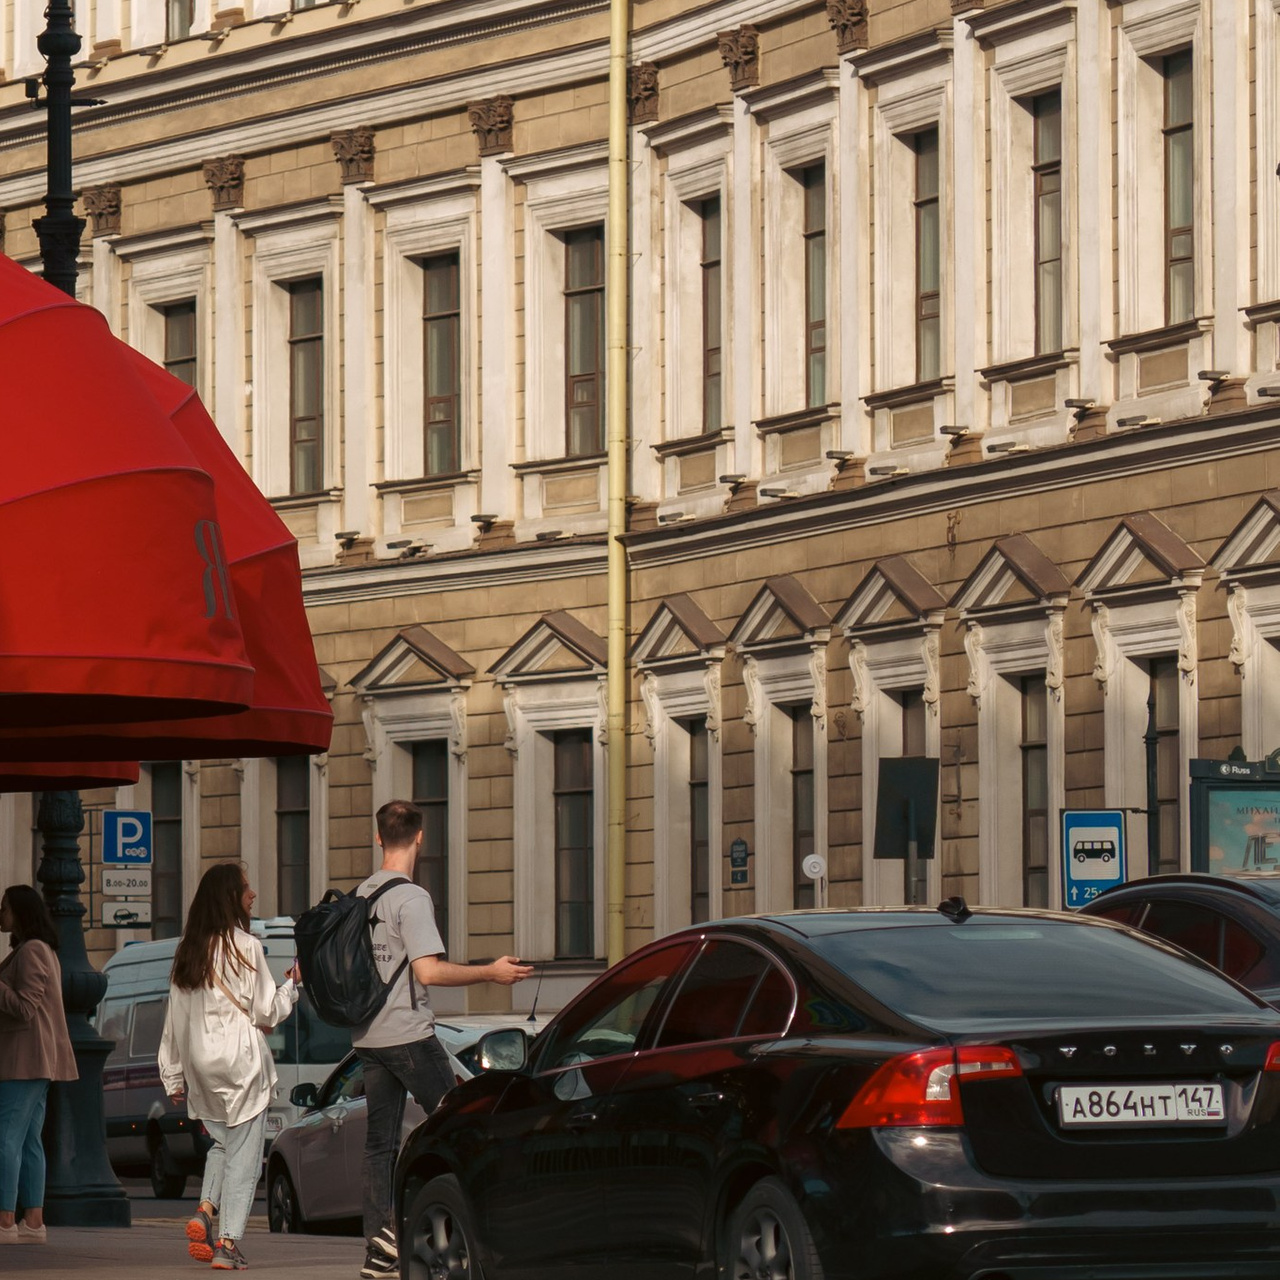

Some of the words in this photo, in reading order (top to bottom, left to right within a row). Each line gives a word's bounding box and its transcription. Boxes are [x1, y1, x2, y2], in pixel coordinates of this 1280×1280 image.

[117, 817, 143, 858] P
[1059, 1044, 1234, 1058] VOLVO
[1178, 1087, 1214, 1108] 147
[1187, 1108, 1206, 1117] RUS
